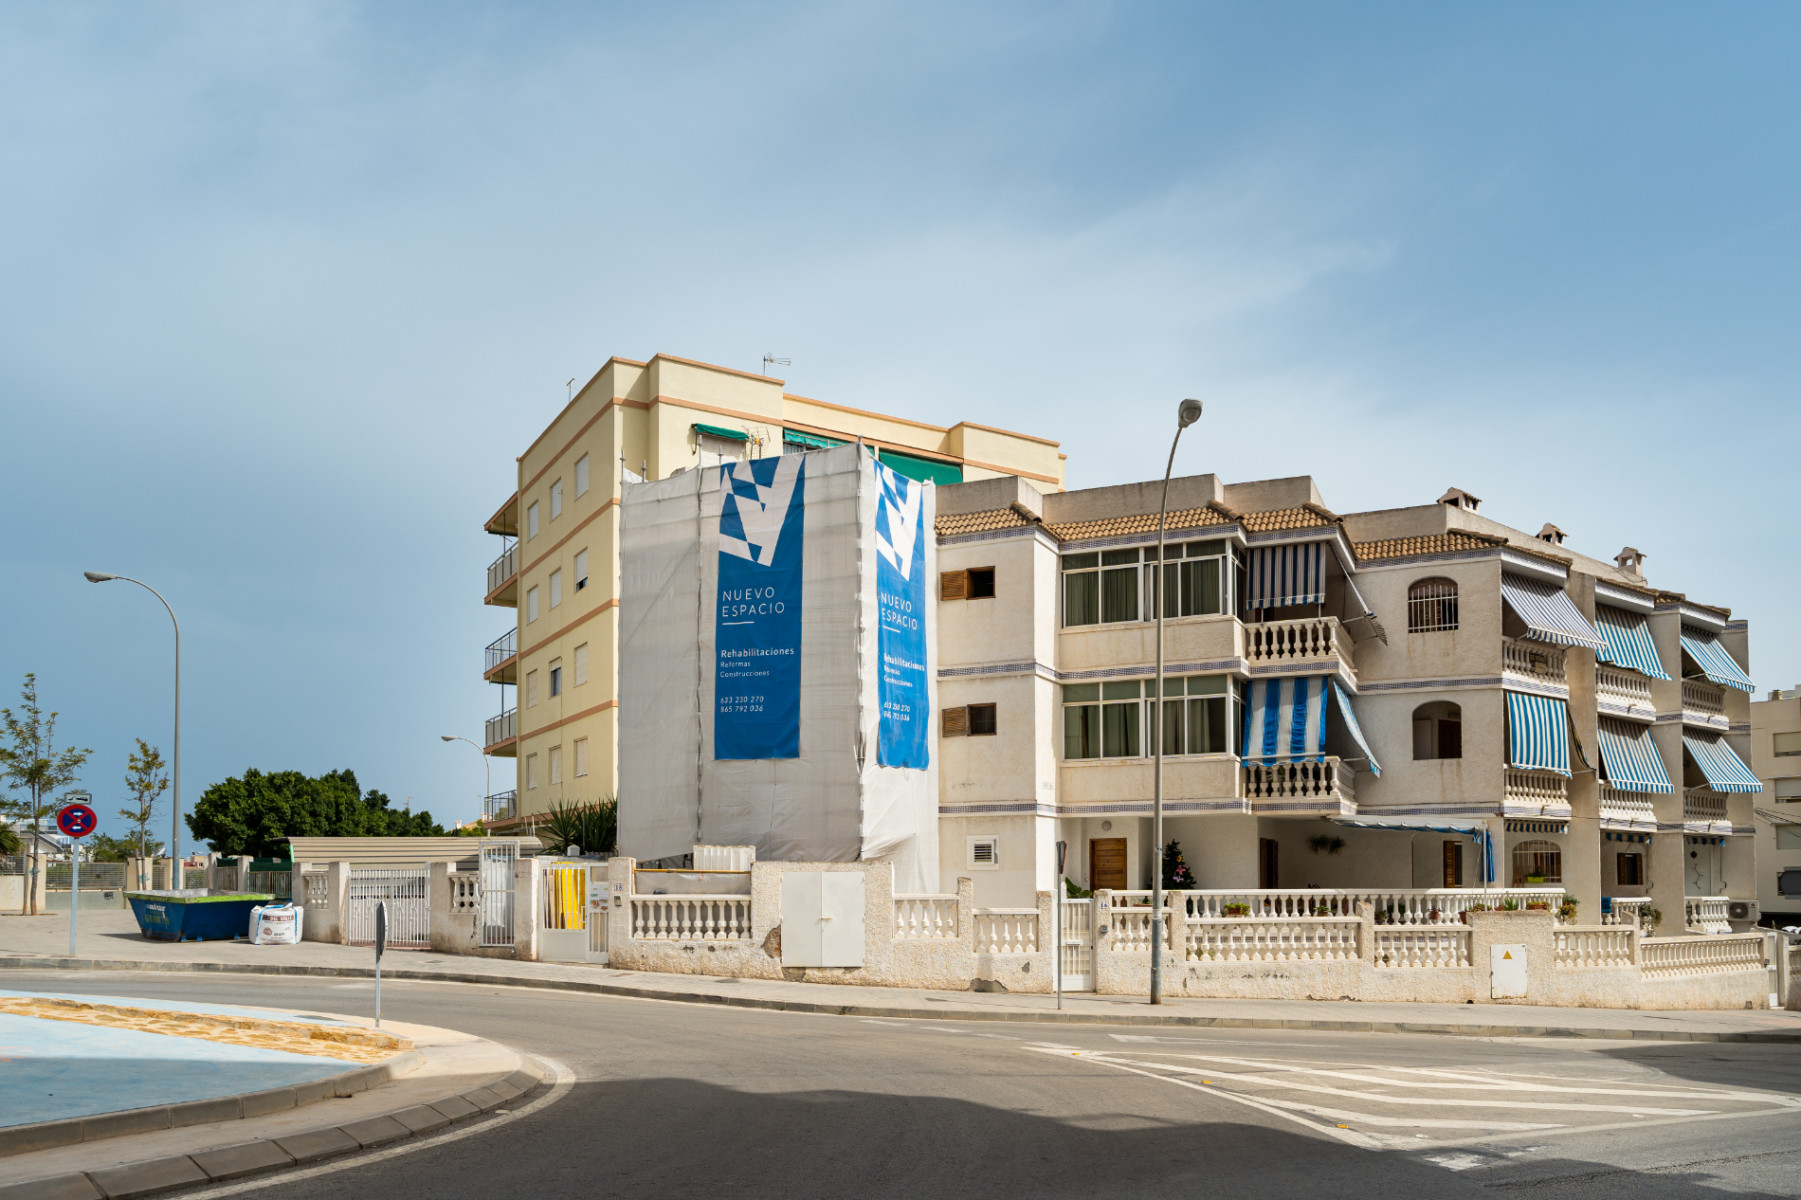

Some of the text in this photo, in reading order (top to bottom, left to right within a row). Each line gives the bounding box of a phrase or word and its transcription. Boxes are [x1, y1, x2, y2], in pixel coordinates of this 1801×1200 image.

[722, 586, 775, 601] NUEVO
[881, 591, 912, 613] NUEVO
[722, 601, 785, 617] ESPACIO
[881, 607, 918, 631] ESPACIO
[720, 647, 795, 658] Rehabilitaciones
[720, 670, 770, 678] Construcciones
[720, 695, 764, 704] 633 230 270
[720, 705, 733, 713] 865
[900, 704, 911, 712] 270
